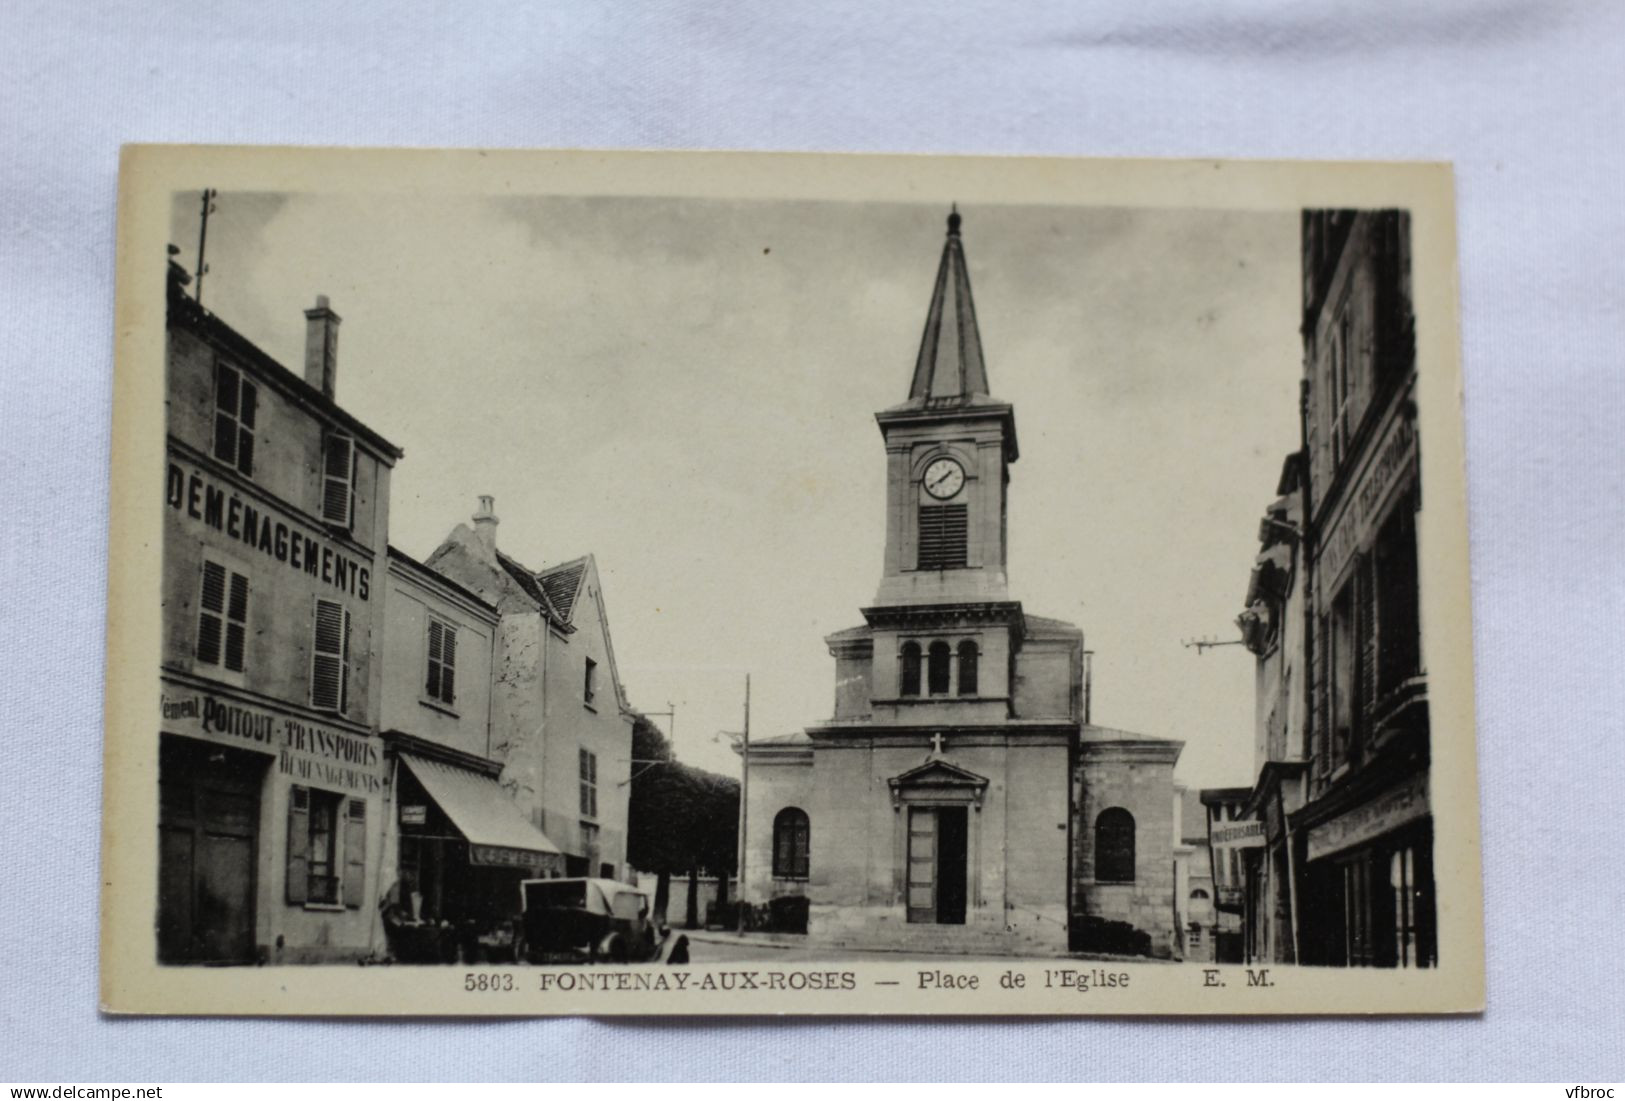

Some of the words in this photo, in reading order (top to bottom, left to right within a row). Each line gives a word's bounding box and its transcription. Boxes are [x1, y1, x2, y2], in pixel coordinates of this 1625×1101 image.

[167, 463, 370, 601] DÉMÉNAGEMENTS
[285, 719, 379, 766] TRANSPORTS
[464, 972, 521, 992] 5803.
[539, 971, 857, 992] FONTENAY-AUX-ROSES
[917, 970, 980, 990] Place
[1000, 970, 1026, 989] de
[1044, 969, 1131, 993] l'Eglise
[1203, 968, 1227, 988] E.
[1247, 968, 1275, 988] M.
